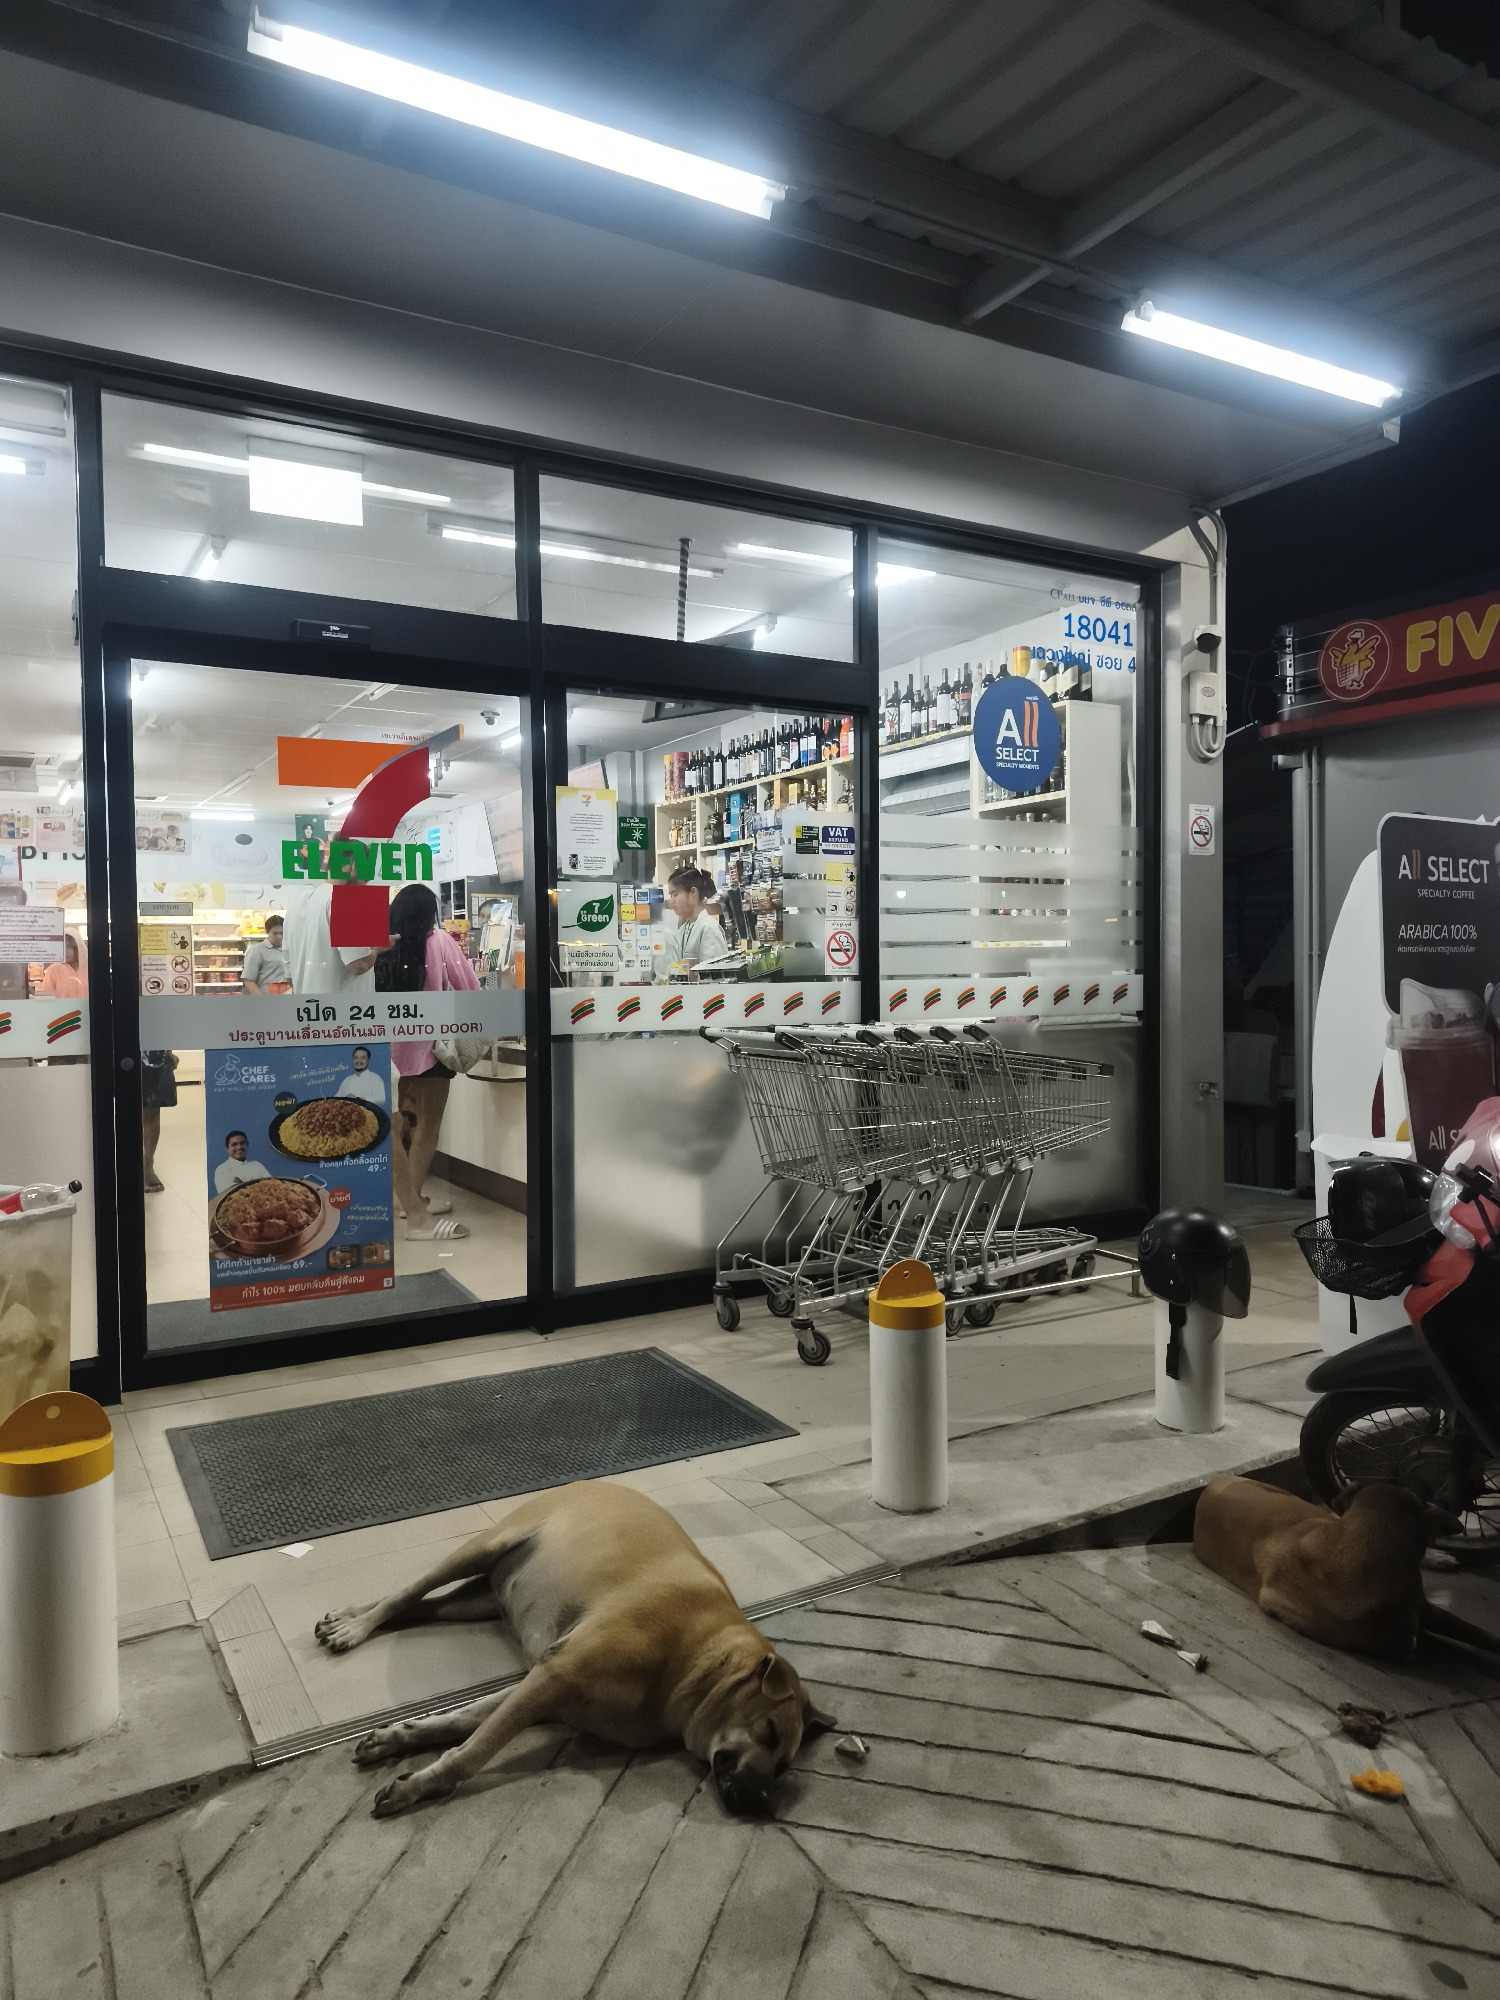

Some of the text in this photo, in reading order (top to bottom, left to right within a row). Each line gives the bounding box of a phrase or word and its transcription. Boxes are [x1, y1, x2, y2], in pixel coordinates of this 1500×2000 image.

[1064, 612, 1133, 647] 18041
[1406, 604, 1500, 673] FIV
[995, 747, 1039, 762] SELECT
[828, 827, 848, 837] VAT
[1427, 856, 1490, 883] SELECT
[1417, 888, 1475, 899] SPECIALTY COFFEE
[581, 914, 609, 923] Green
[1398, 924, 1477, 939] ARABICA 100%
[296, 999, 424, 1023] เปิด 24 ชม.
[228, 1022, 483, 1046] ประตูบานเลื่อนอัตโนมัติ (AUTO DOOR)
[241, 1065, 269, 1075] CHEF
[241, 1074, 276, 1084] CARES
[1428, 1125, 1446, 1150] All
[241, 1286, 260, 1299] กำไร
[262, 1286, 286, 1296] 100%
